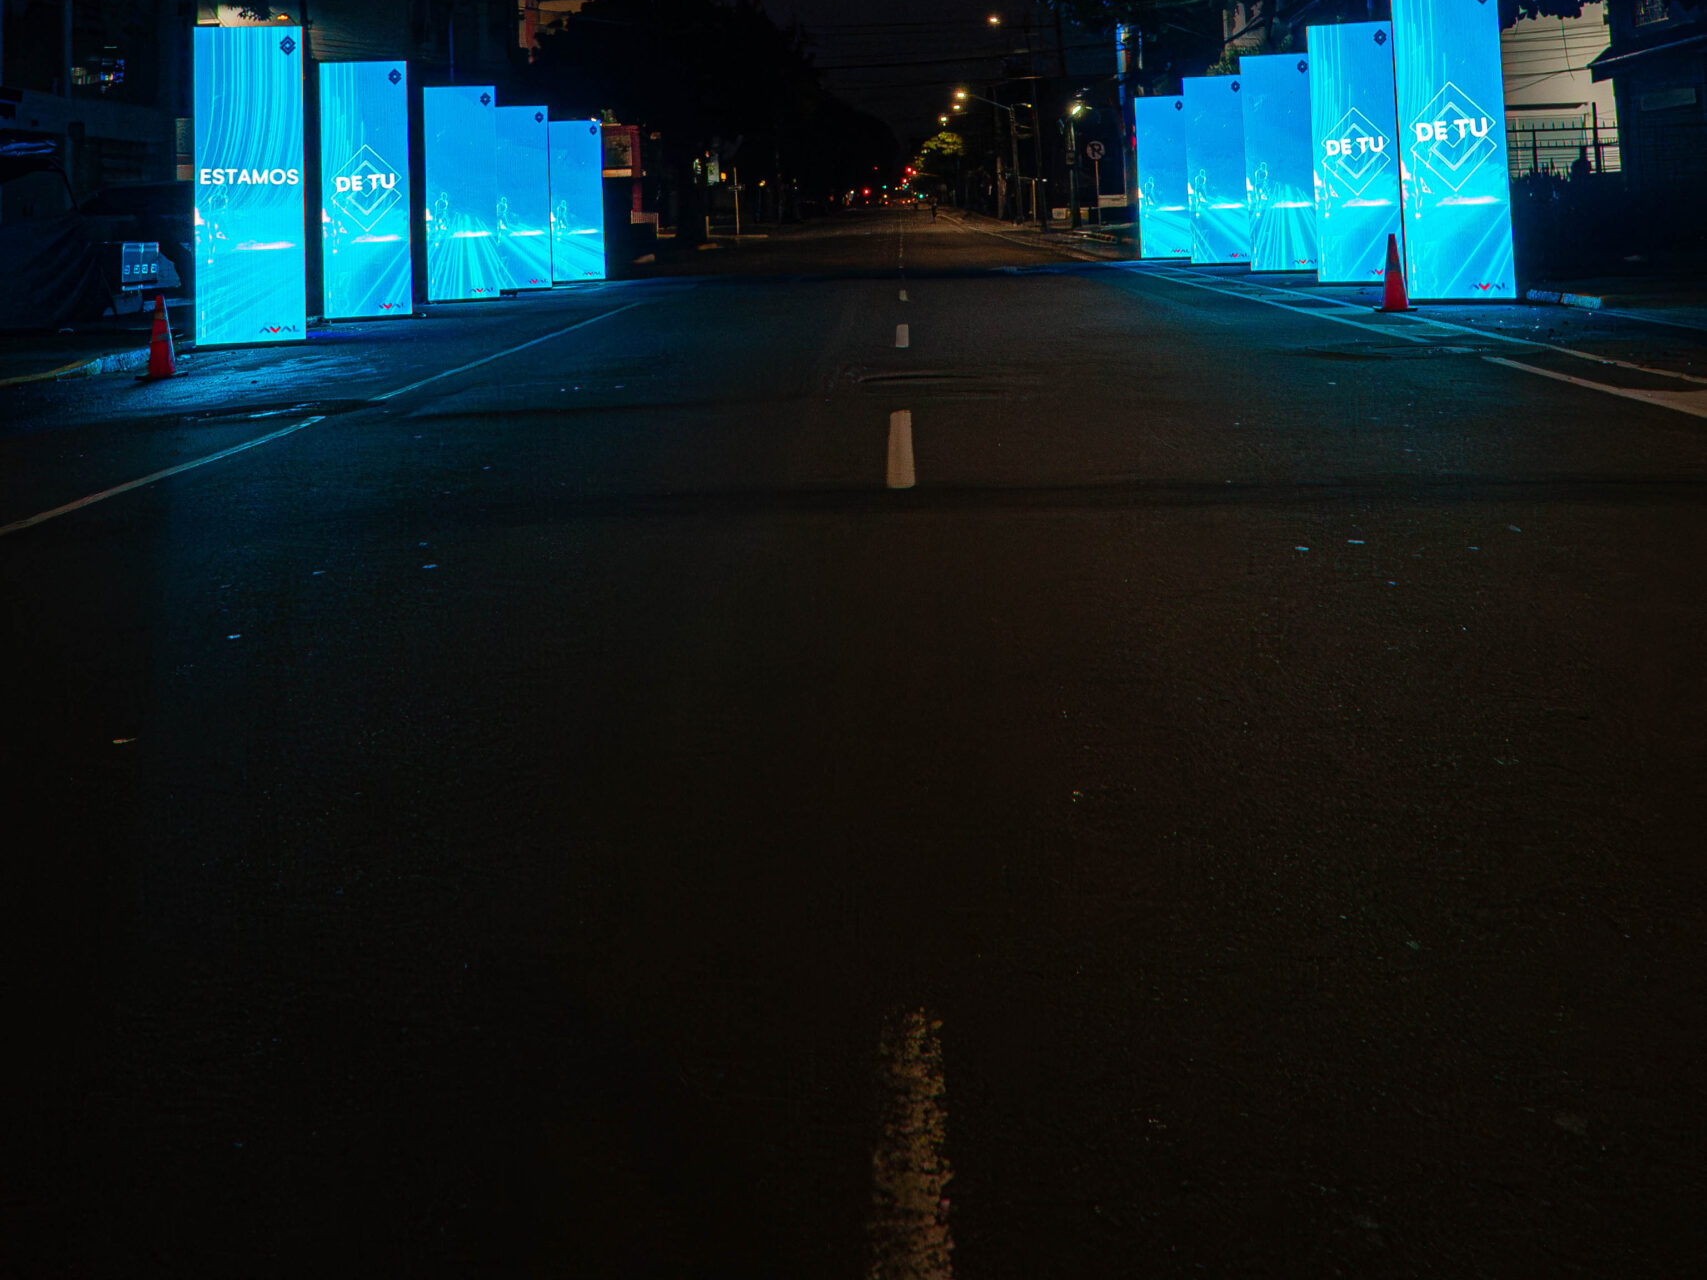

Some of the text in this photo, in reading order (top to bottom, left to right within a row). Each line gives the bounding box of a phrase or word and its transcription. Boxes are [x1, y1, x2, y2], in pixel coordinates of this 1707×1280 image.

[1415, 116, 1489, 142] DE TU
[1326, 135, 1385, 157] DE TU
[200, 169, 299, 185] ESTAMOS
[335, 173, 395, 193] DE TU
